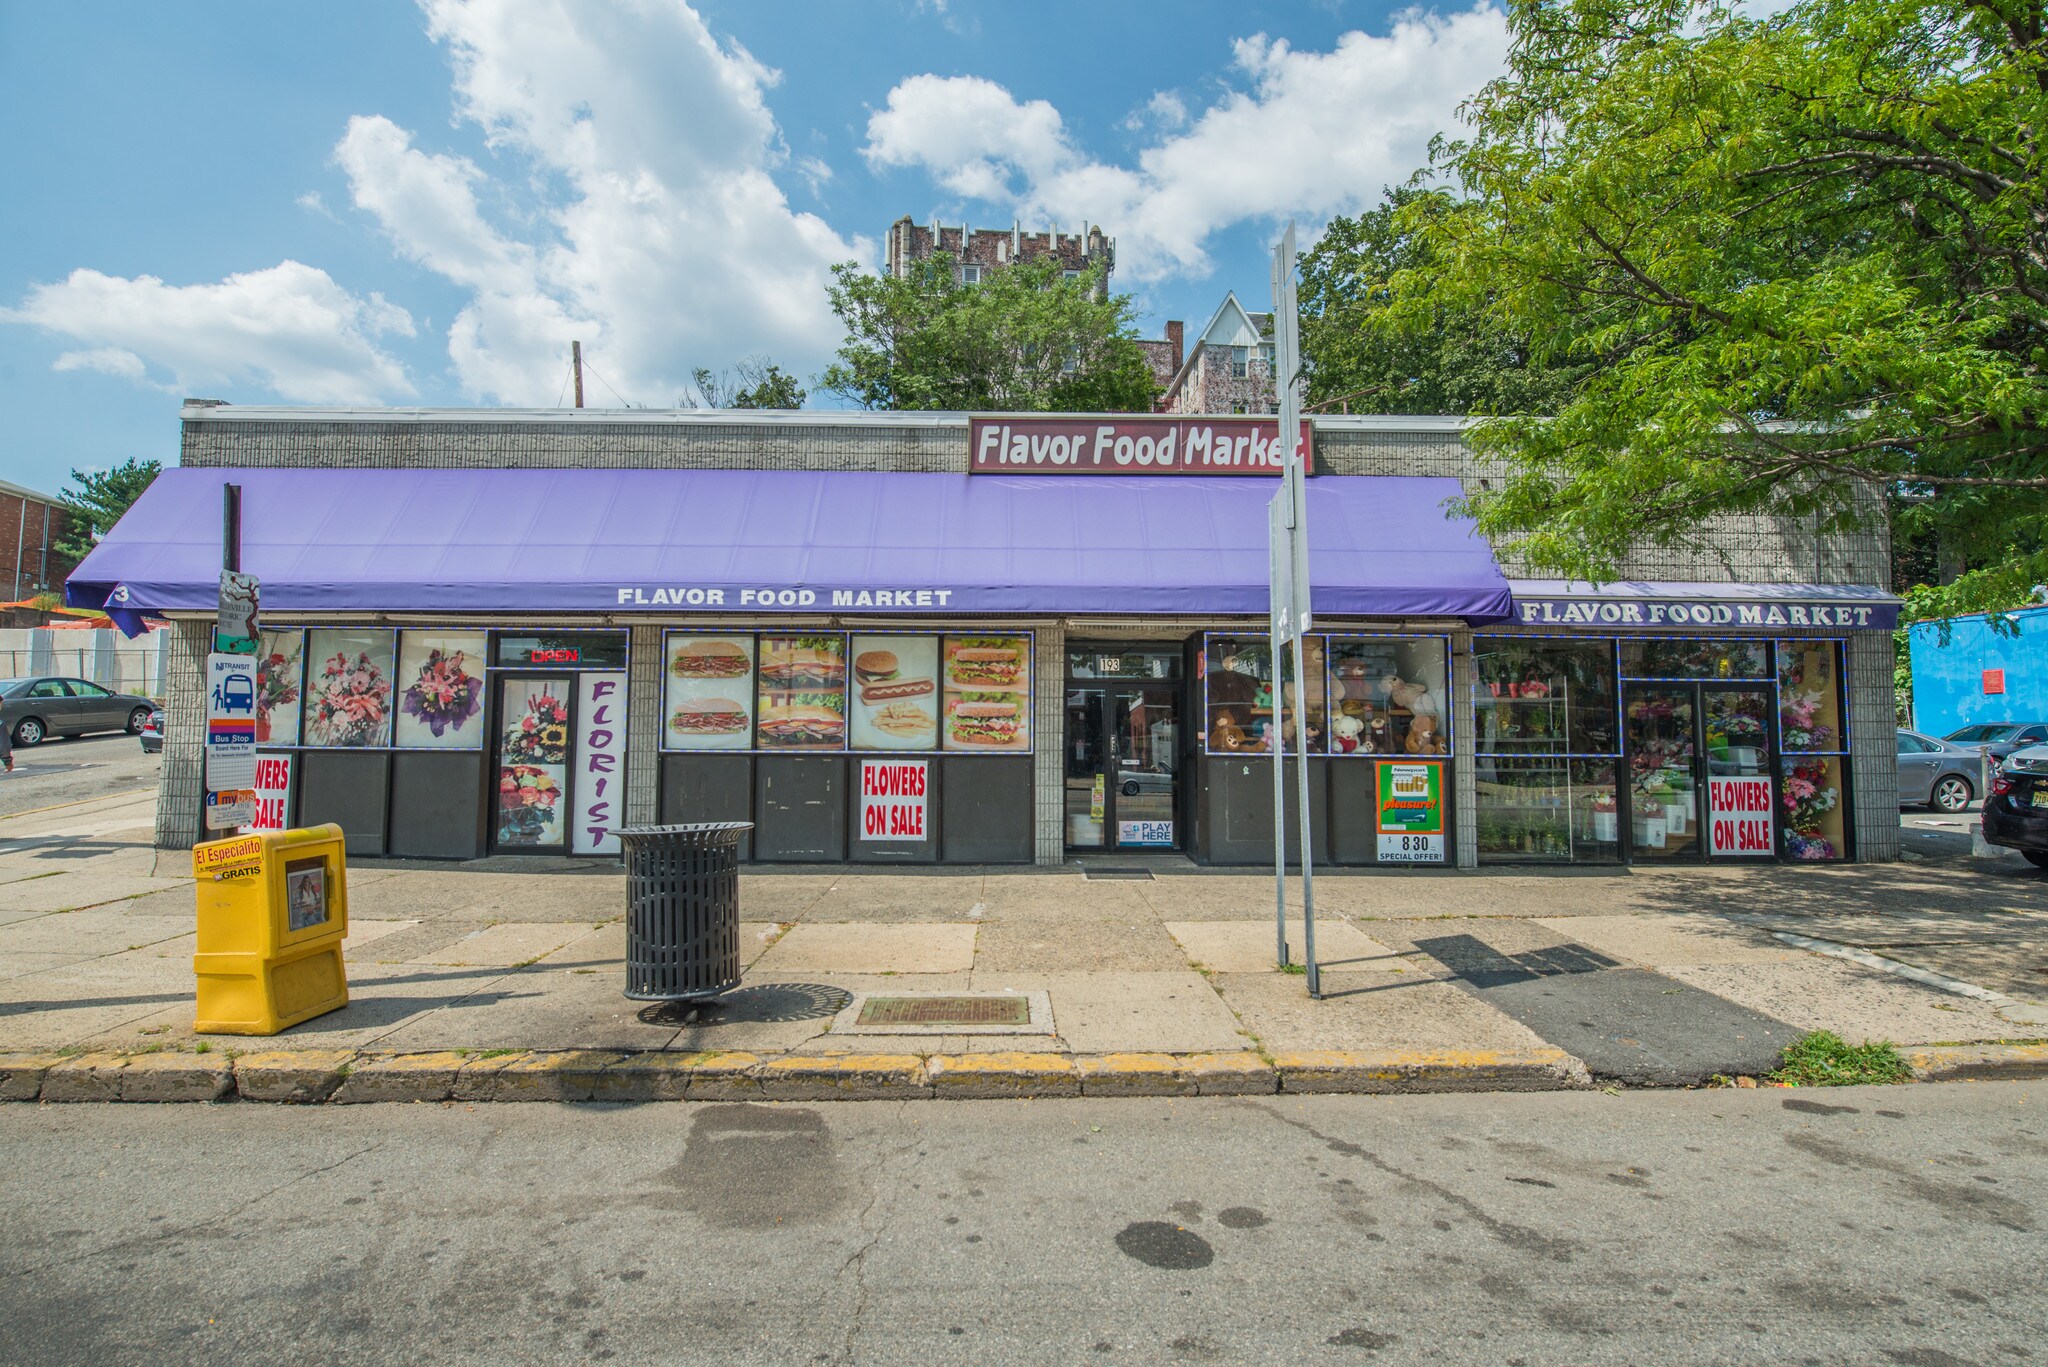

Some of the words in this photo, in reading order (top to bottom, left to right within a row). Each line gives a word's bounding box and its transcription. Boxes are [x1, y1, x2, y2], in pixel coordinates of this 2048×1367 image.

[978, 425, 1086, 465] Flavor
[1093, 425, 1177, 466] Food
[114, 585, 130, 602] 3
[617, 587, 724, 605] FLAVOR
[740, 588, 816, 606] FOOD
[832, 589, 952, 607] MARKET
[220, 602, 253, 613] LEVILLE
[1521, 602, 1643, 622] FLAVOR
[1648, 603, 1733, 624] FOOD
[1737, 605, 1873, 626] MARKET
[531, 648, 579, 663] OPEN
[1102, 659, 1119, 671] 193
[215, 734, 230, 743] Bus
[231, 734, 250, 743] Stop
[587, 680, 616, 848] FLORIST
[254, 759, 289, 790] WERS
[864, 765, 926, 797] FLOWERS
[1383, 798, 1437, 811] pleasure!
[1710, 781, 1770, 812] FLOWERS
[865, 804, 887, 836] ON
[890, 804, 922, 836] SALE
[1142, 823, 1171, 832] PLAY
[1142, 831, 1171, 841] HERE
[1387, 836, 1392, 844] $
[1714, 819, 1735, 851] ON
[1738, 819, 1770, 851] SALE
[196, 849, 206, 865] El
[208, 840, 261, 863] Especialito
[222, 865, 261, 880] GRATIS
